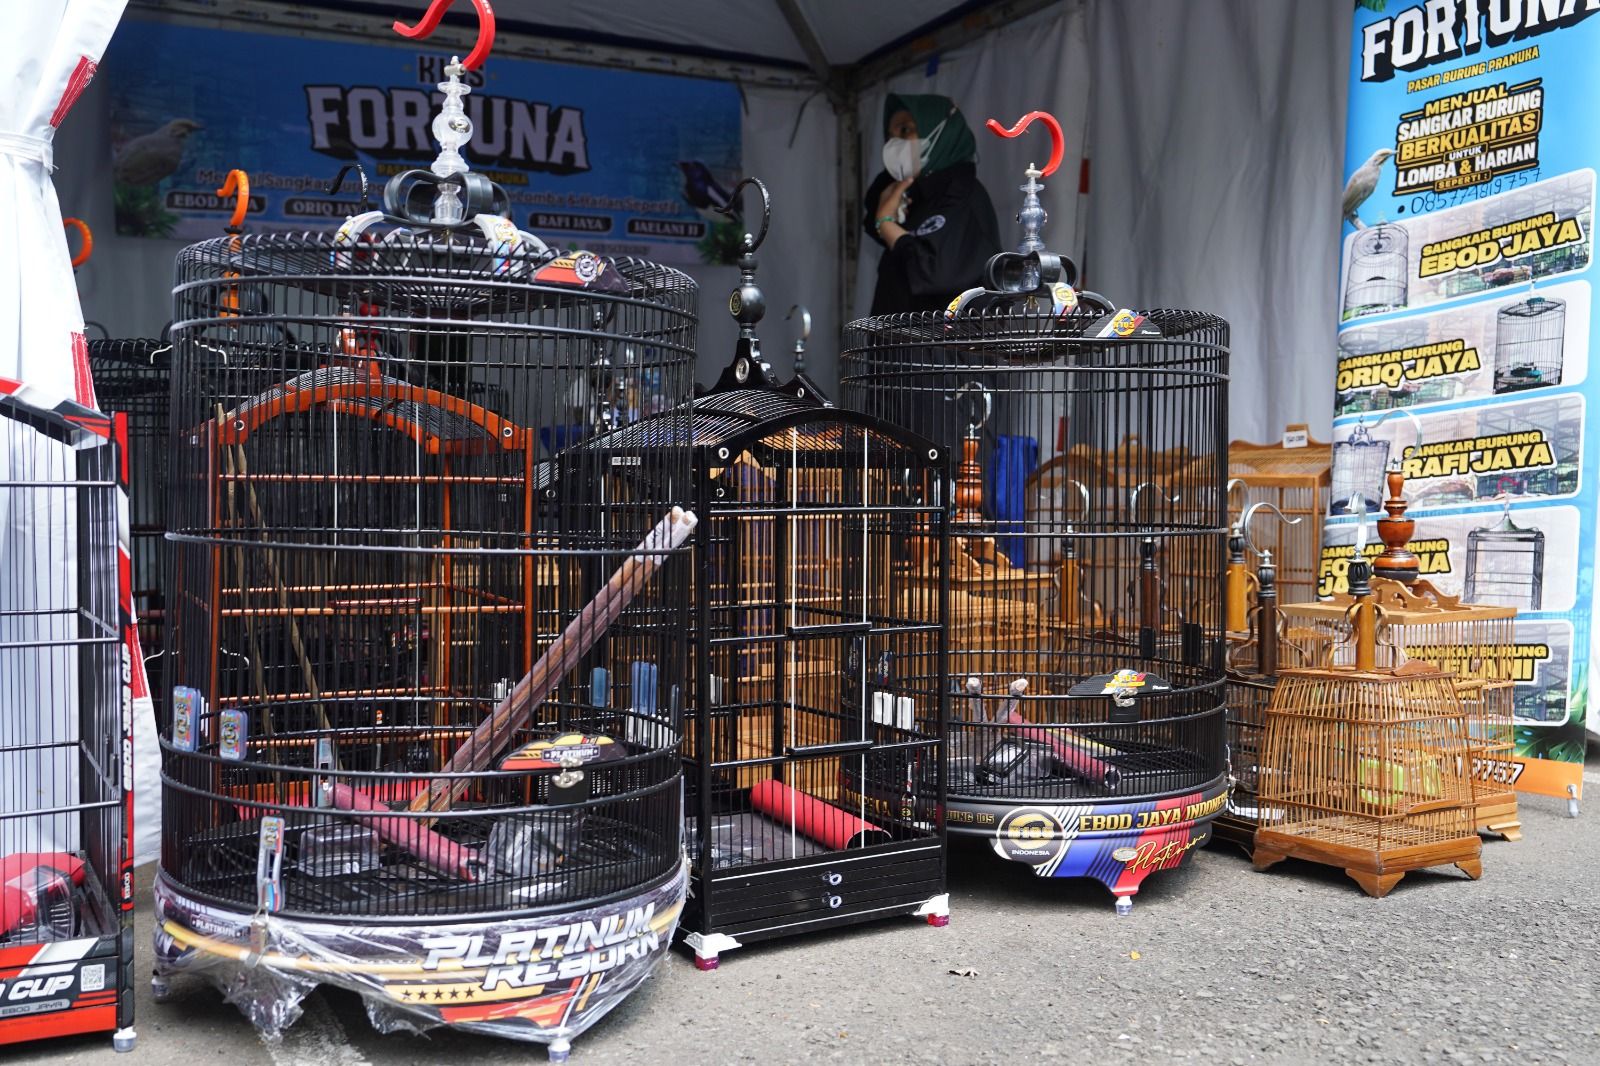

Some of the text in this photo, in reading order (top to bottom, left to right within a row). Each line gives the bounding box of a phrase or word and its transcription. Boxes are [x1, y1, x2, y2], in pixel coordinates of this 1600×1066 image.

[1407, 46, 1540, 93] PASAR BURUNG PRAMUKA
[1397, 89, 1542, 142] SANGKAR BURUNG
[1426, 84, 1509, 117] MENJUAL
[1400, 112, 1536, 161] BERKUALITAS
[1449, 145, 1483, 161] UNTUK
[1397, 141, 1537, 188] LOMBA & HARIAN
[1438, 175, 1482, 190] SEPERTI
[174, 195, 220, 208] EBOD
[292, 201, 333, 217] ORIQ
[538, 214, 604, 231] RAFI JAYA
[1422, 213, 1555, 257] SANGKAR BURUNG
[1419, 219, 1582, 278] EBOD JAYA
[1336, 347, 1480, 391] ORIQ JAYA
[1337, 339, 1464, 372] SANGKAR BURUNG
[1402, 442, 1553, 480] RAFI JAYA
[1403, 430, 1541, 459] SANGKAR BURUNG
[1079, 813, 1133, 832] EBOD
[1136, 806, 1182, 829] JAYA
[419, 901, 657, 970] PLATINUM
[481, 930, 660, 991] REBORN
[7, 974, 75, 1001] CUP
